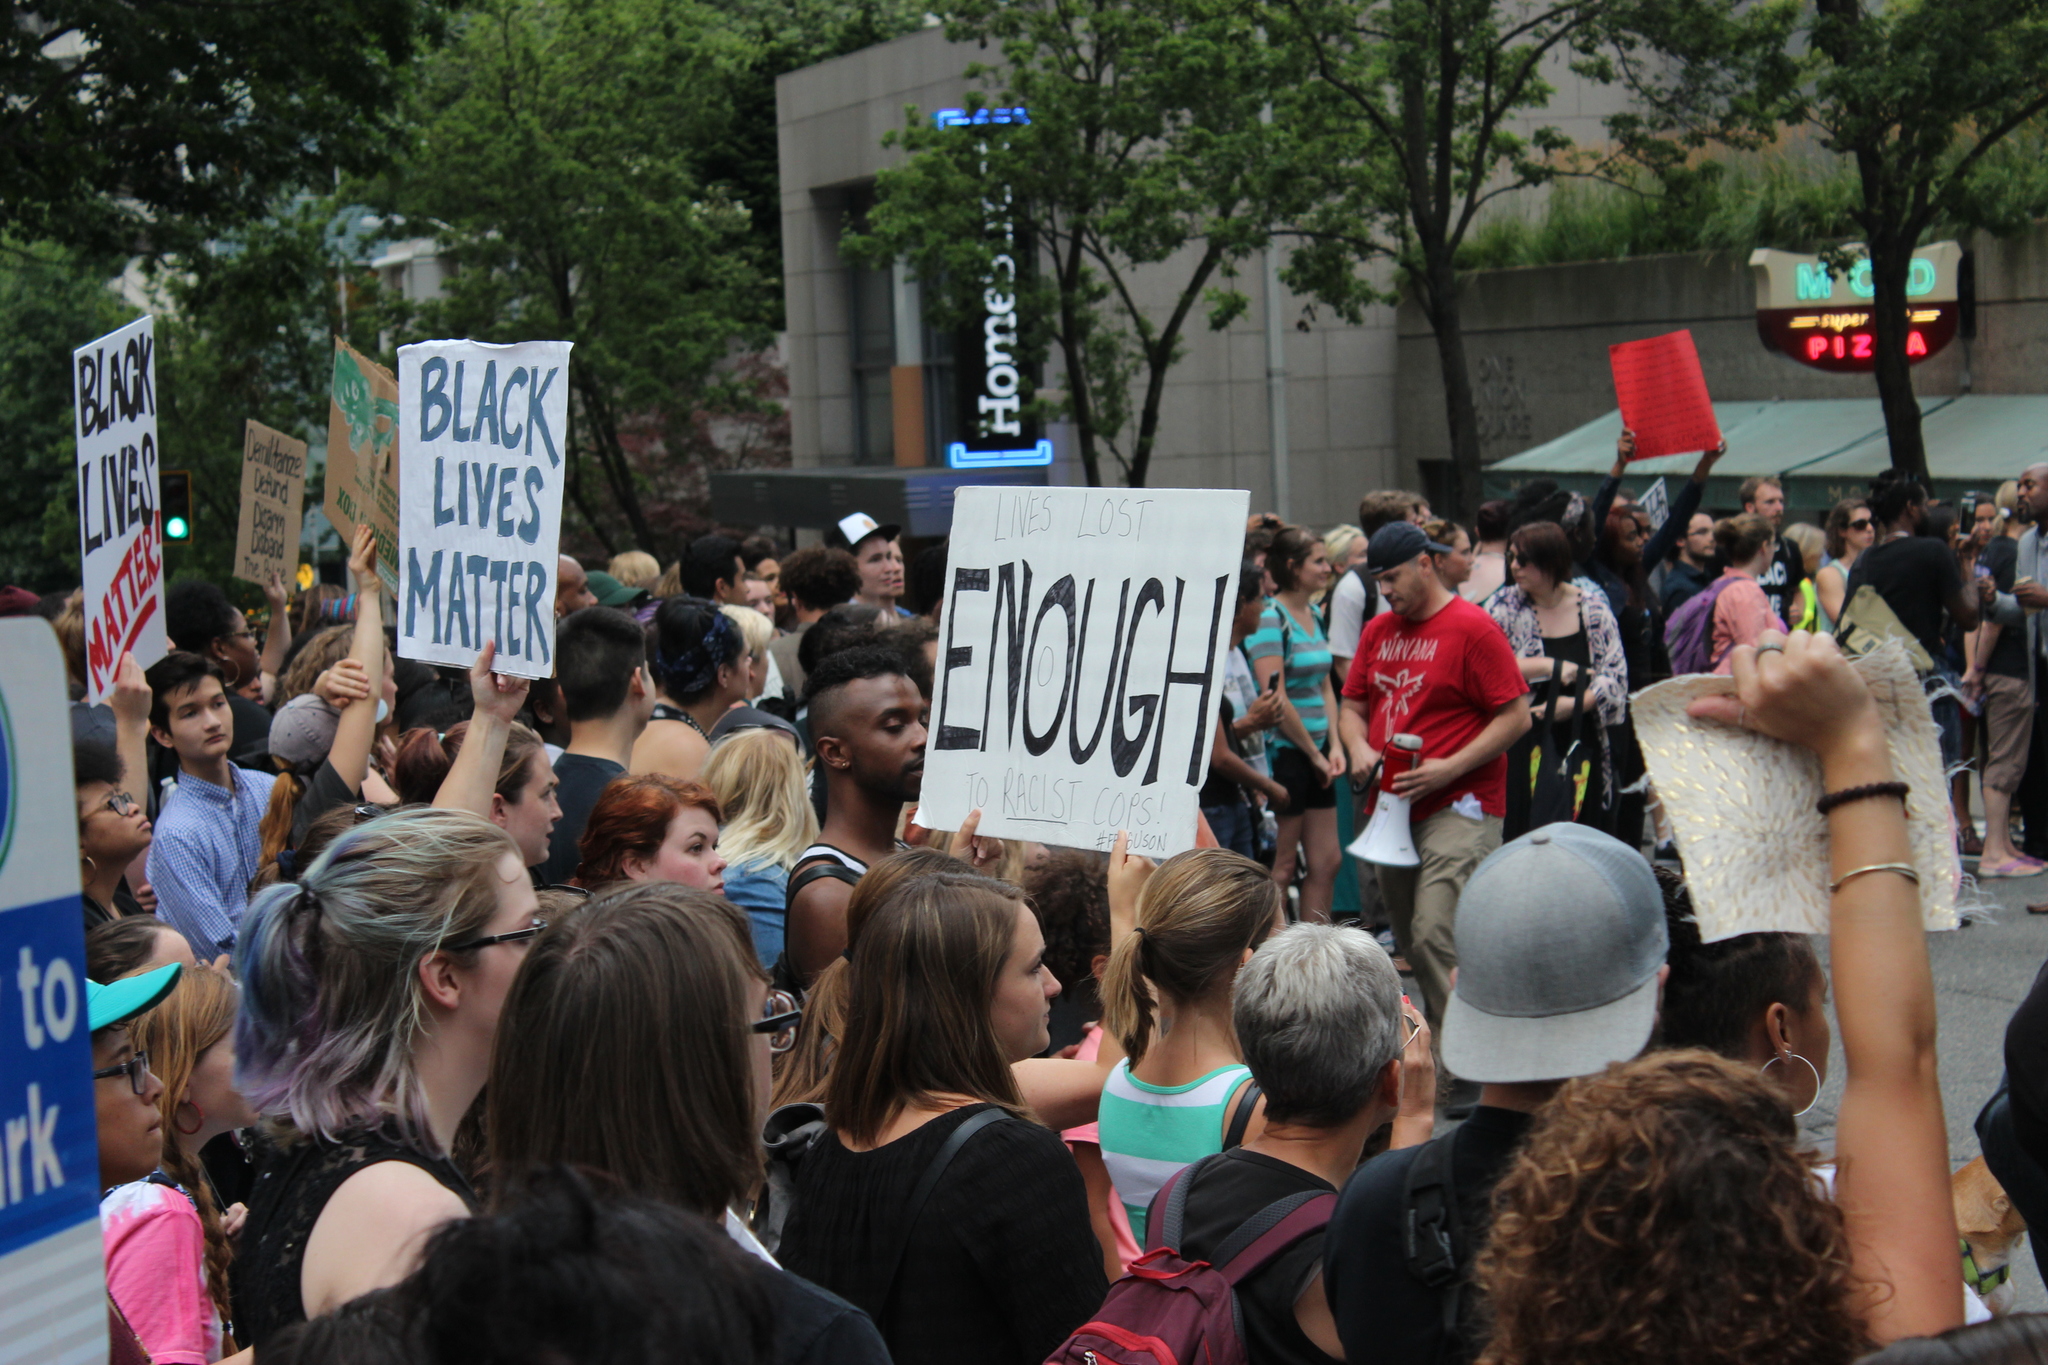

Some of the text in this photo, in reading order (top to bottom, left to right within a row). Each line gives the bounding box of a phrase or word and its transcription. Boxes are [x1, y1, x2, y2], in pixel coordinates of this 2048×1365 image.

[1796, 258, 1936, 300] MOD
[1820, 312, 1870, 333] super
[79, 332, 155, 438] BLACK
[1807, 332, 1927, 360] PIZA
[420, 356, 561, 470] BLACK
[82, 432, 155, 558] LIVES
[254, 468, 289, 505] Defund
[434, 455, 545, 546] LIVES
[995, 491, 1154, 541] LIVES LOST
[88, 510, 162, 695] MATTER!
[244, 556, 260, 579] The
[404, 547, 550, 665] MATTER
[934, 559, 1230, 786] ENOUGH
[966, 767, 1166, 831] TO RACIST COPS!
[17, 946, 78, 1051] to
